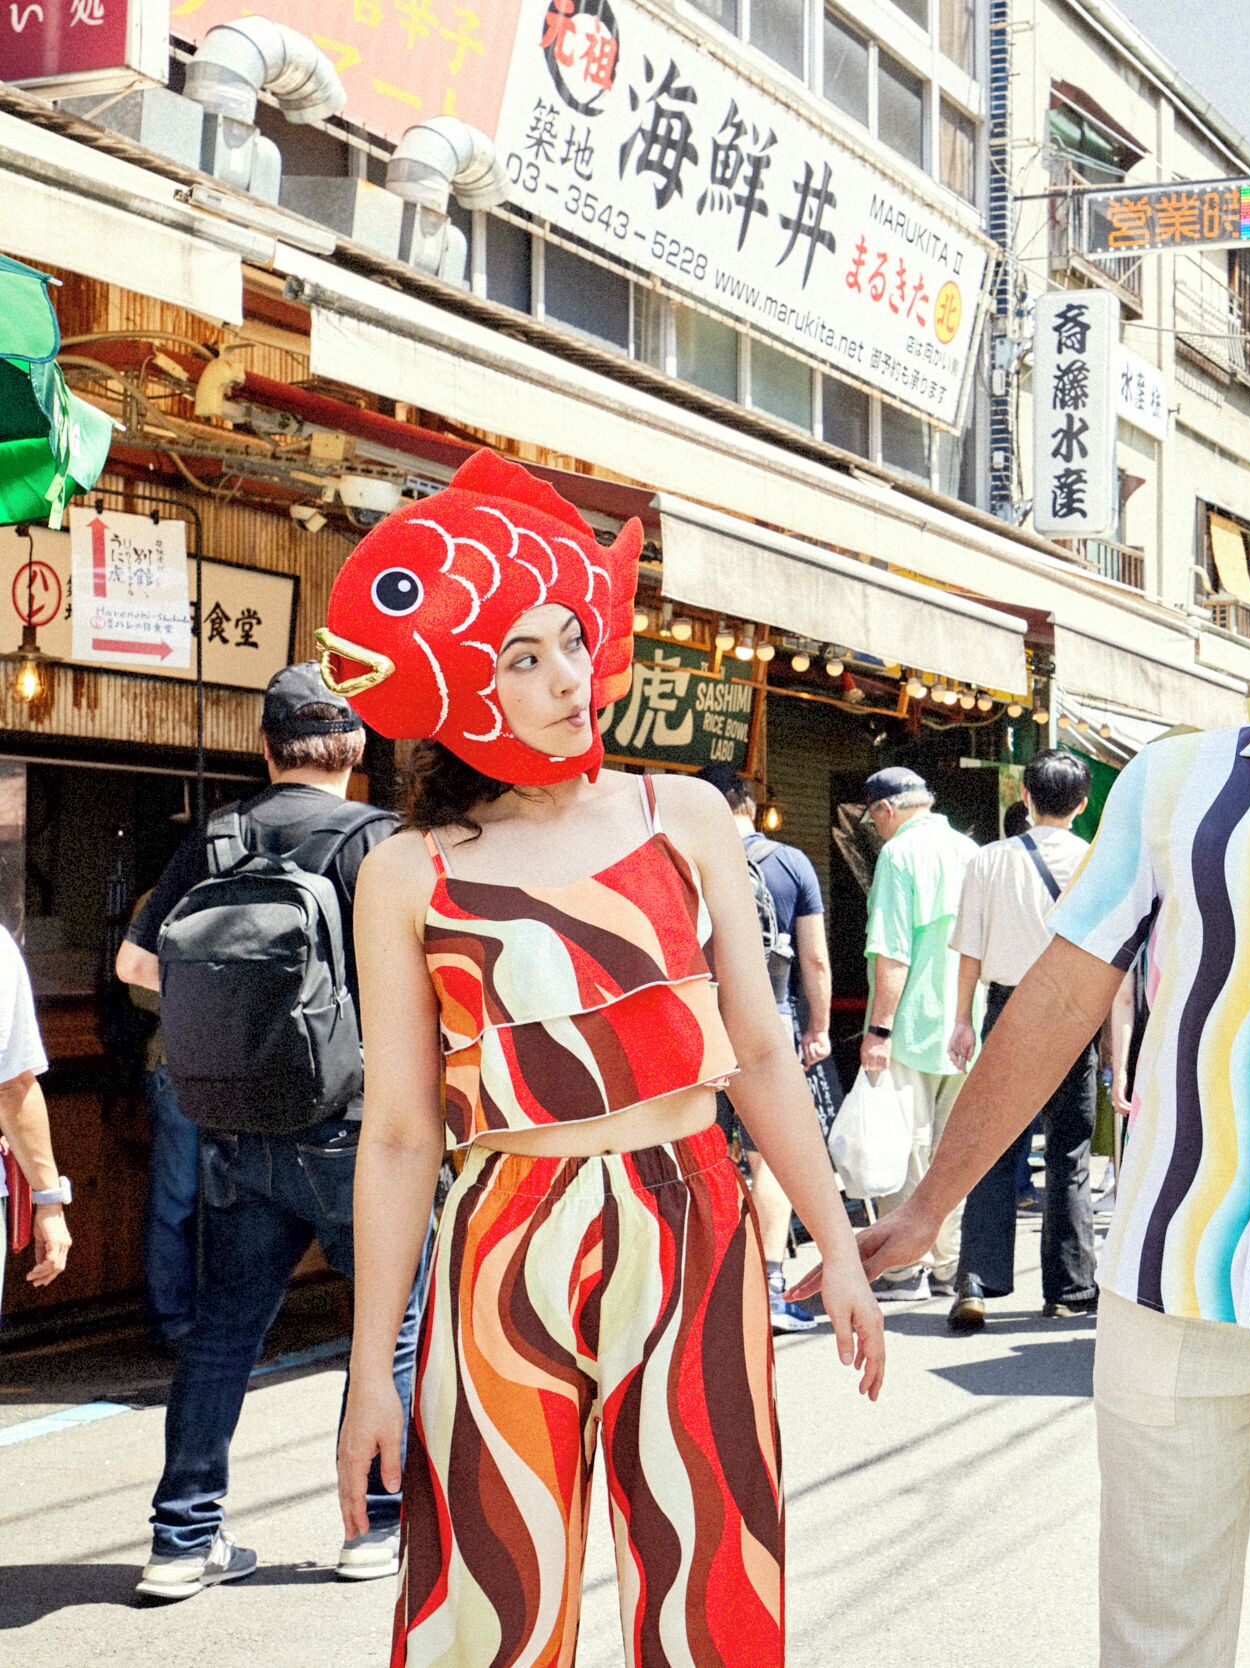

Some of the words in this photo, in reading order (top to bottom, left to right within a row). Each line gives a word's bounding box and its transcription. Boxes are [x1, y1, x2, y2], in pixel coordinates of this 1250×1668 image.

[540, 0, 618, 91] 元祖
[525, 97, 594, 181] 築地
[618, 54, 837, 290] 海鮮丼
[506, 152, 708, 280] 03-3543-5228
[715, 268, 865, 363] www.marukita.net
[869, 194, 948, 268] MARUKITA
[845, 234, 930, 328] まるきた
[598, 648, 694, 749] 虎
[695, 681, 753, 713] SASHIMI
[703, 711, 723, 735] RICE
[725, 715, 749, 743] BOWL
[710, 738, 735, 762] LABO
